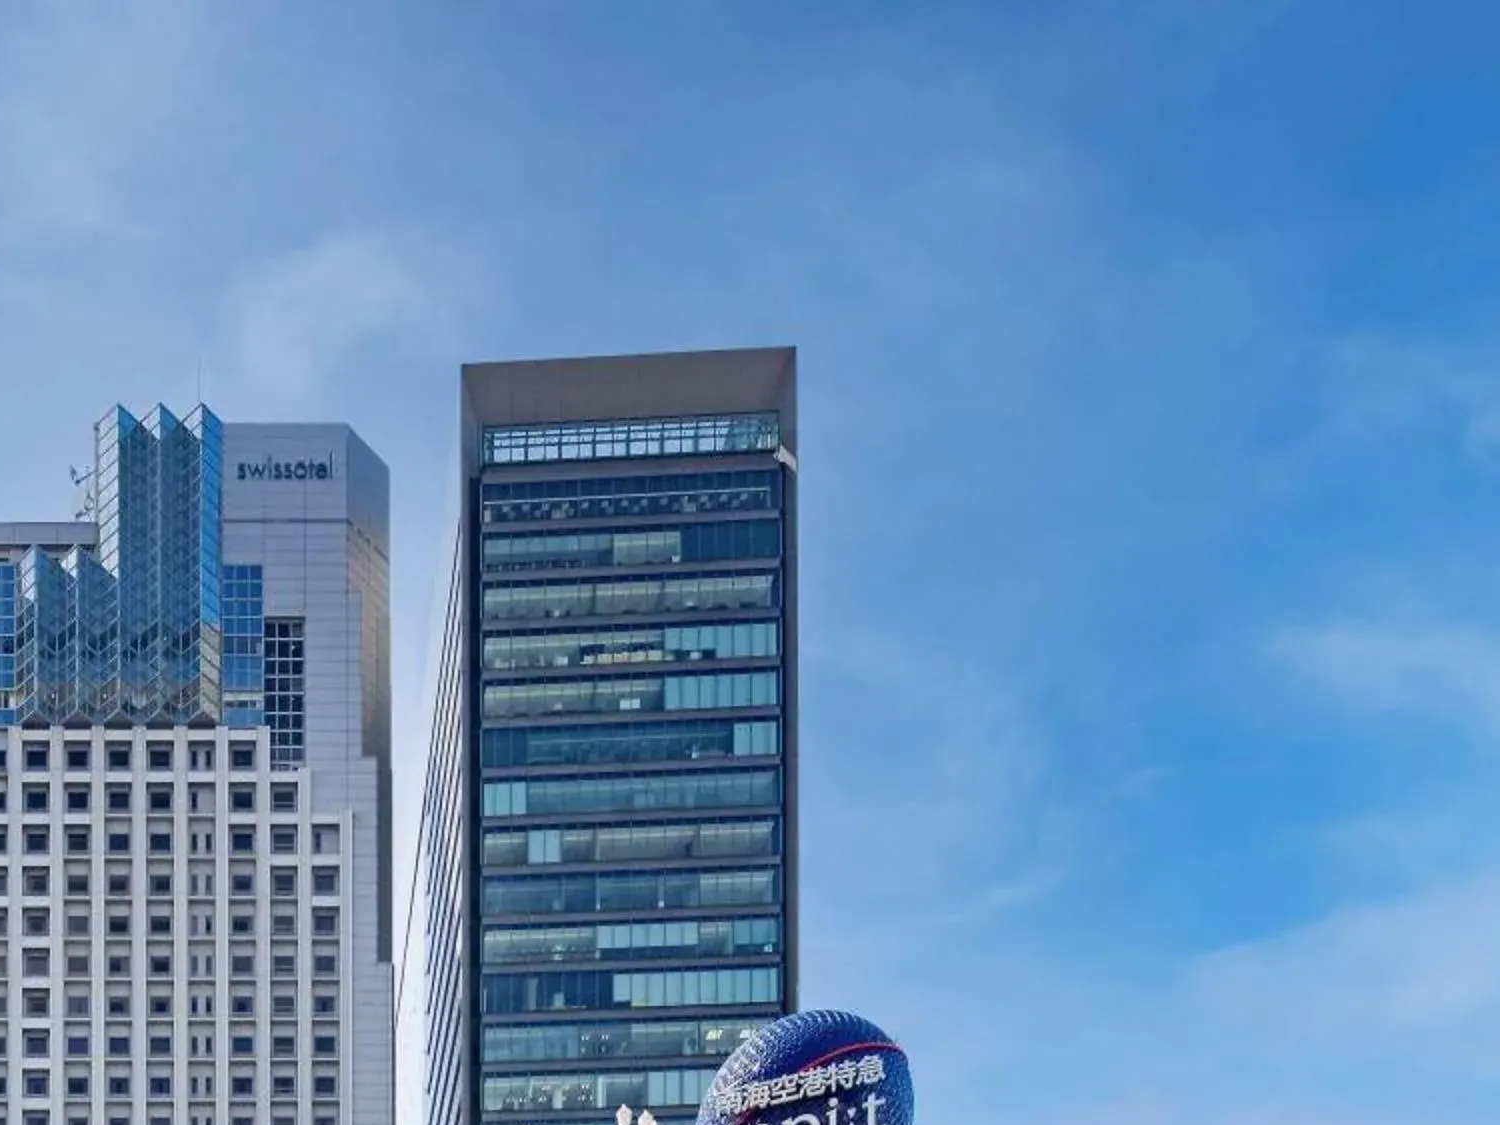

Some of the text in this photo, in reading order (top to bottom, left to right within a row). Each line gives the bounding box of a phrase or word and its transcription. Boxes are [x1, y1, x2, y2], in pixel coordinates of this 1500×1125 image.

[714, 1056, 885, 1115] 南海空港特急
